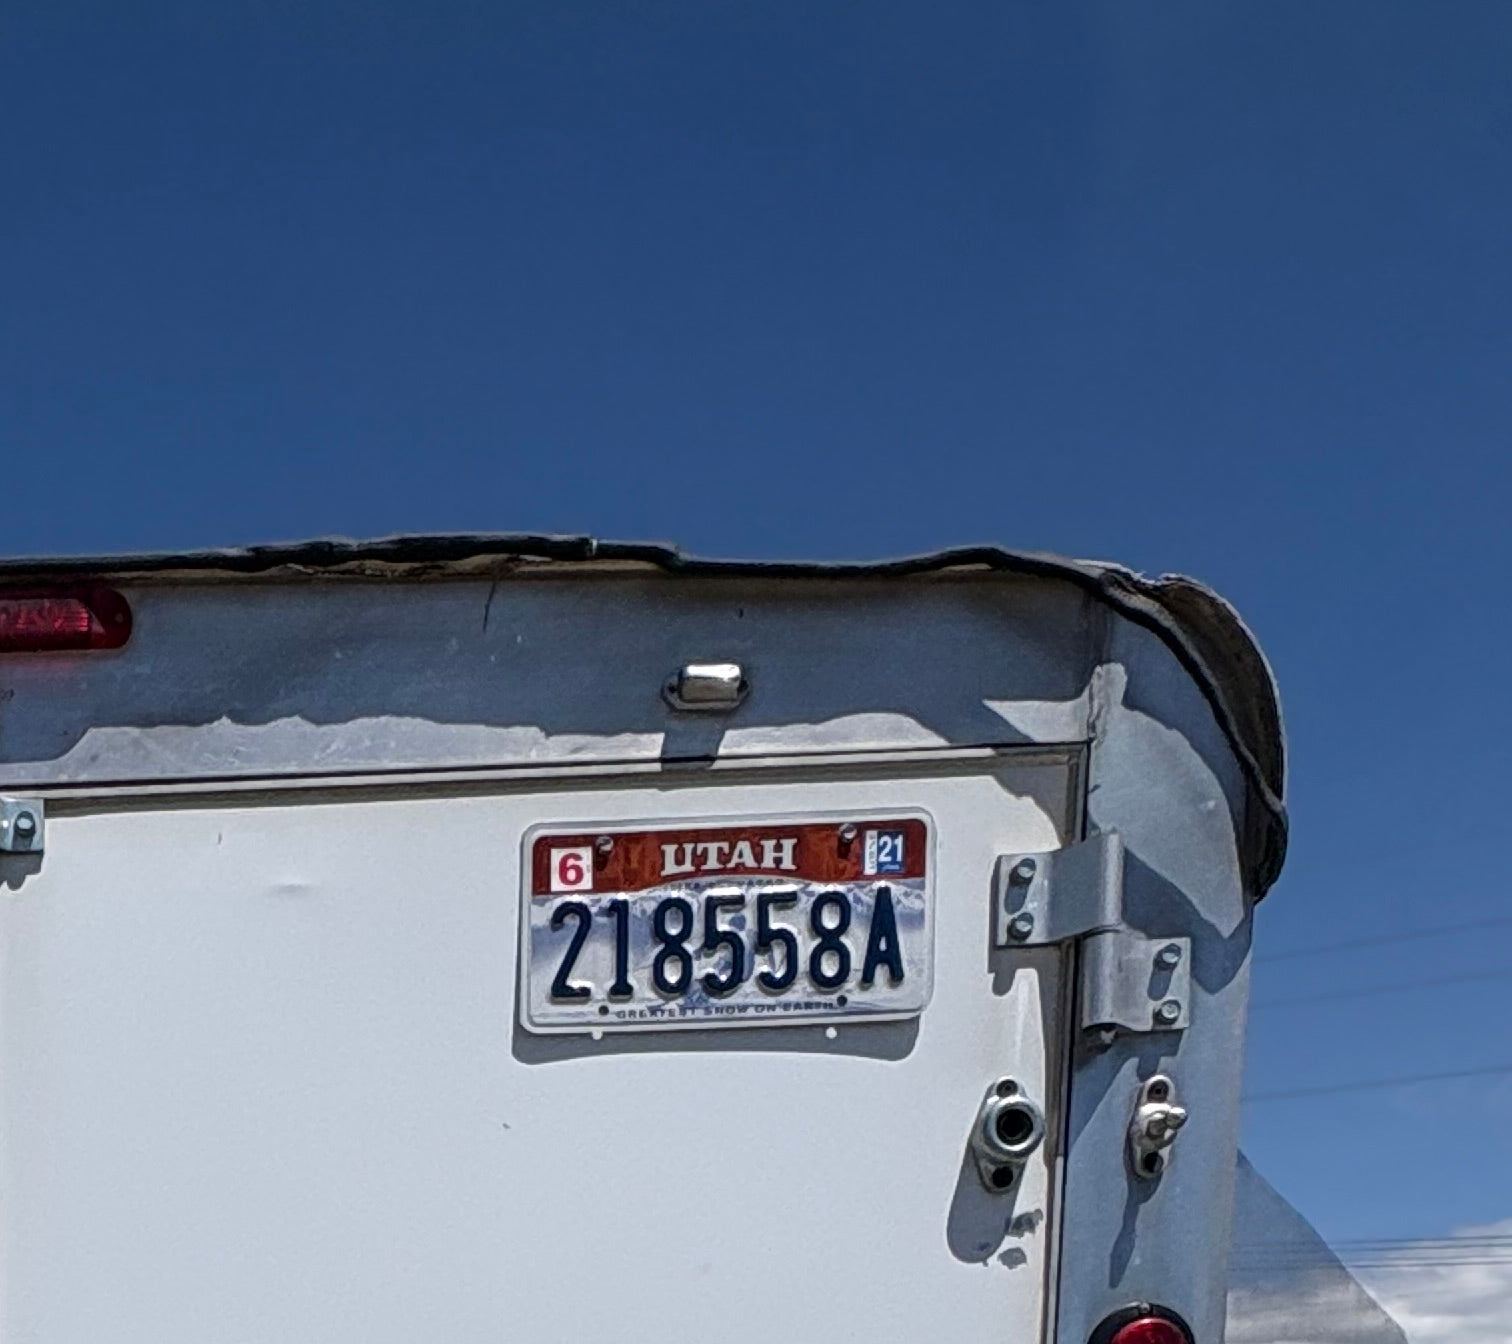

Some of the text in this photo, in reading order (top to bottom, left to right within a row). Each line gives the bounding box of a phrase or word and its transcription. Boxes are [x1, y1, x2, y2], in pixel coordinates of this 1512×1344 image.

[660, 837, 799, 877] UTAH
[878, 834, 904, 863] 21
[558, 852, 584, 886] 6
[550, 885, 904, 1000] 218558A
[615, 1006, 696, 1019] GREATEST
[704, 1005, 748, 1016] SNOW
